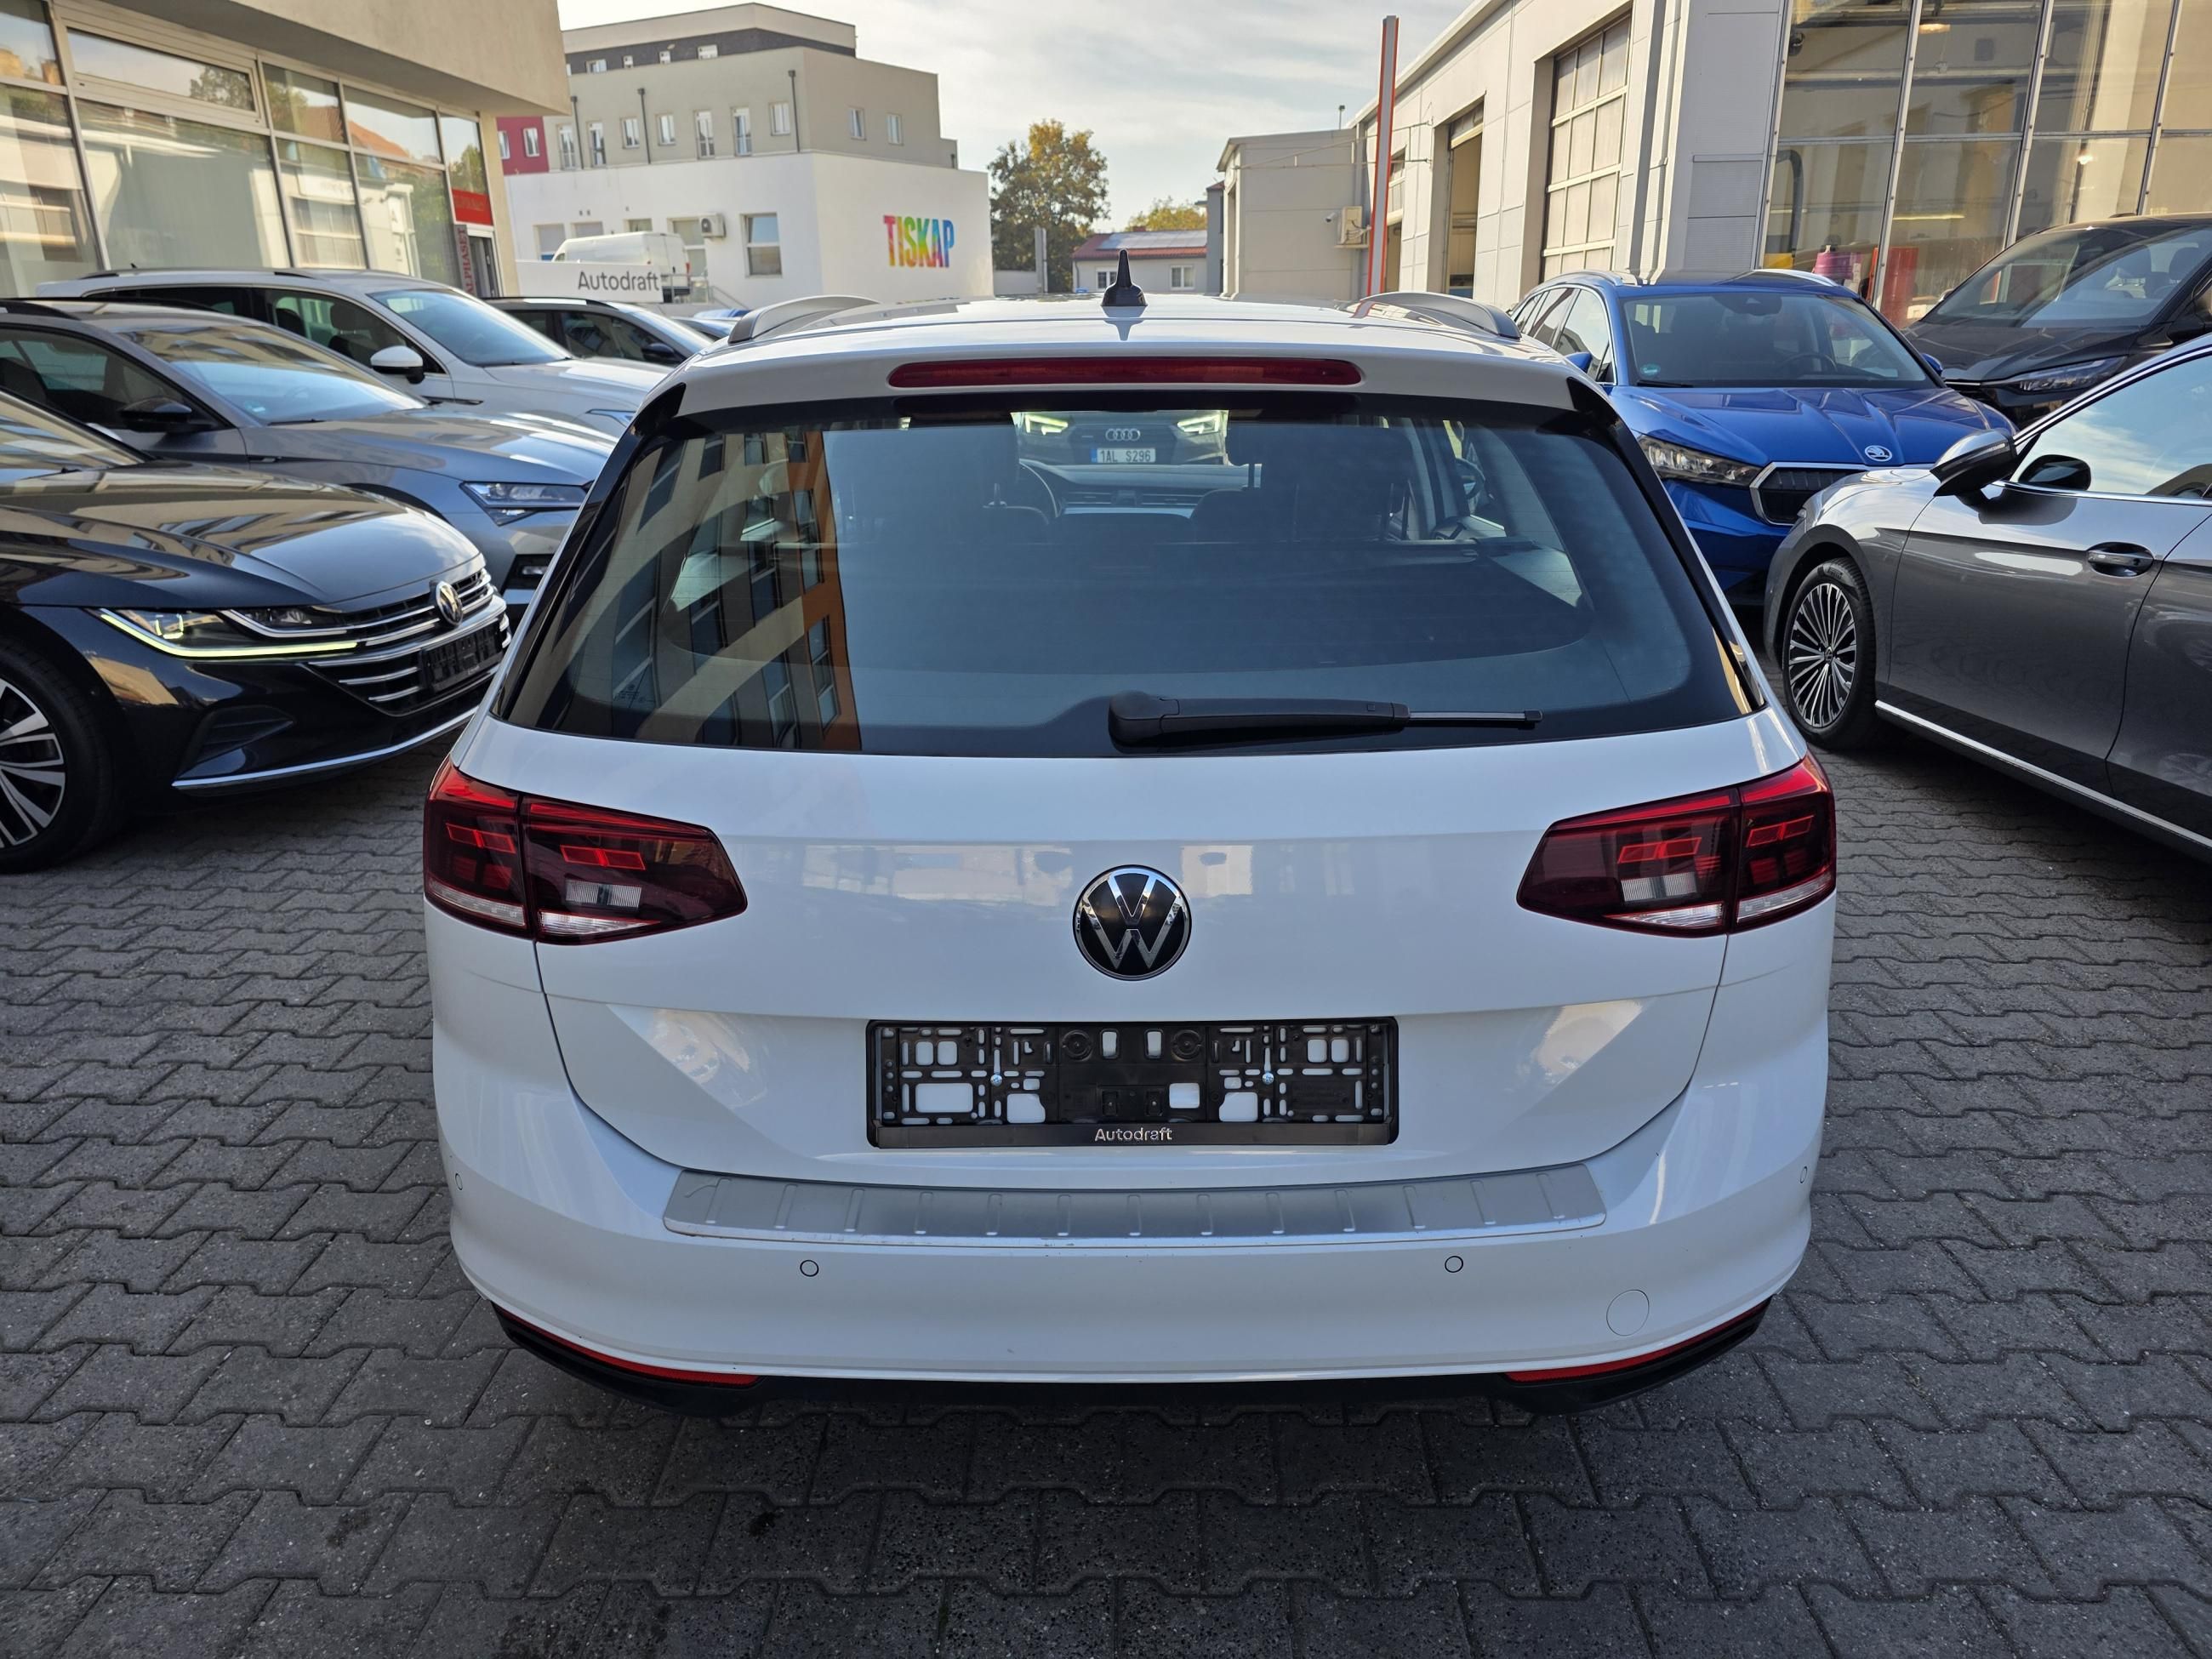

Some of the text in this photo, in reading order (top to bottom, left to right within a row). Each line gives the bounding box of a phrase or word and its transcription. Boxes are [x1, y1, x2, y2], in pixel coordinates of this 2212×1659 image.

[883, 215, 955, 268] TISKAP
[578, 271, 660, 291] Autodraft
[1100, 450, 1151, 462] 1AL S296
[1078, 869, 1185, 973] VW
[1094, 1127, 1172, 1141] Autodraft
